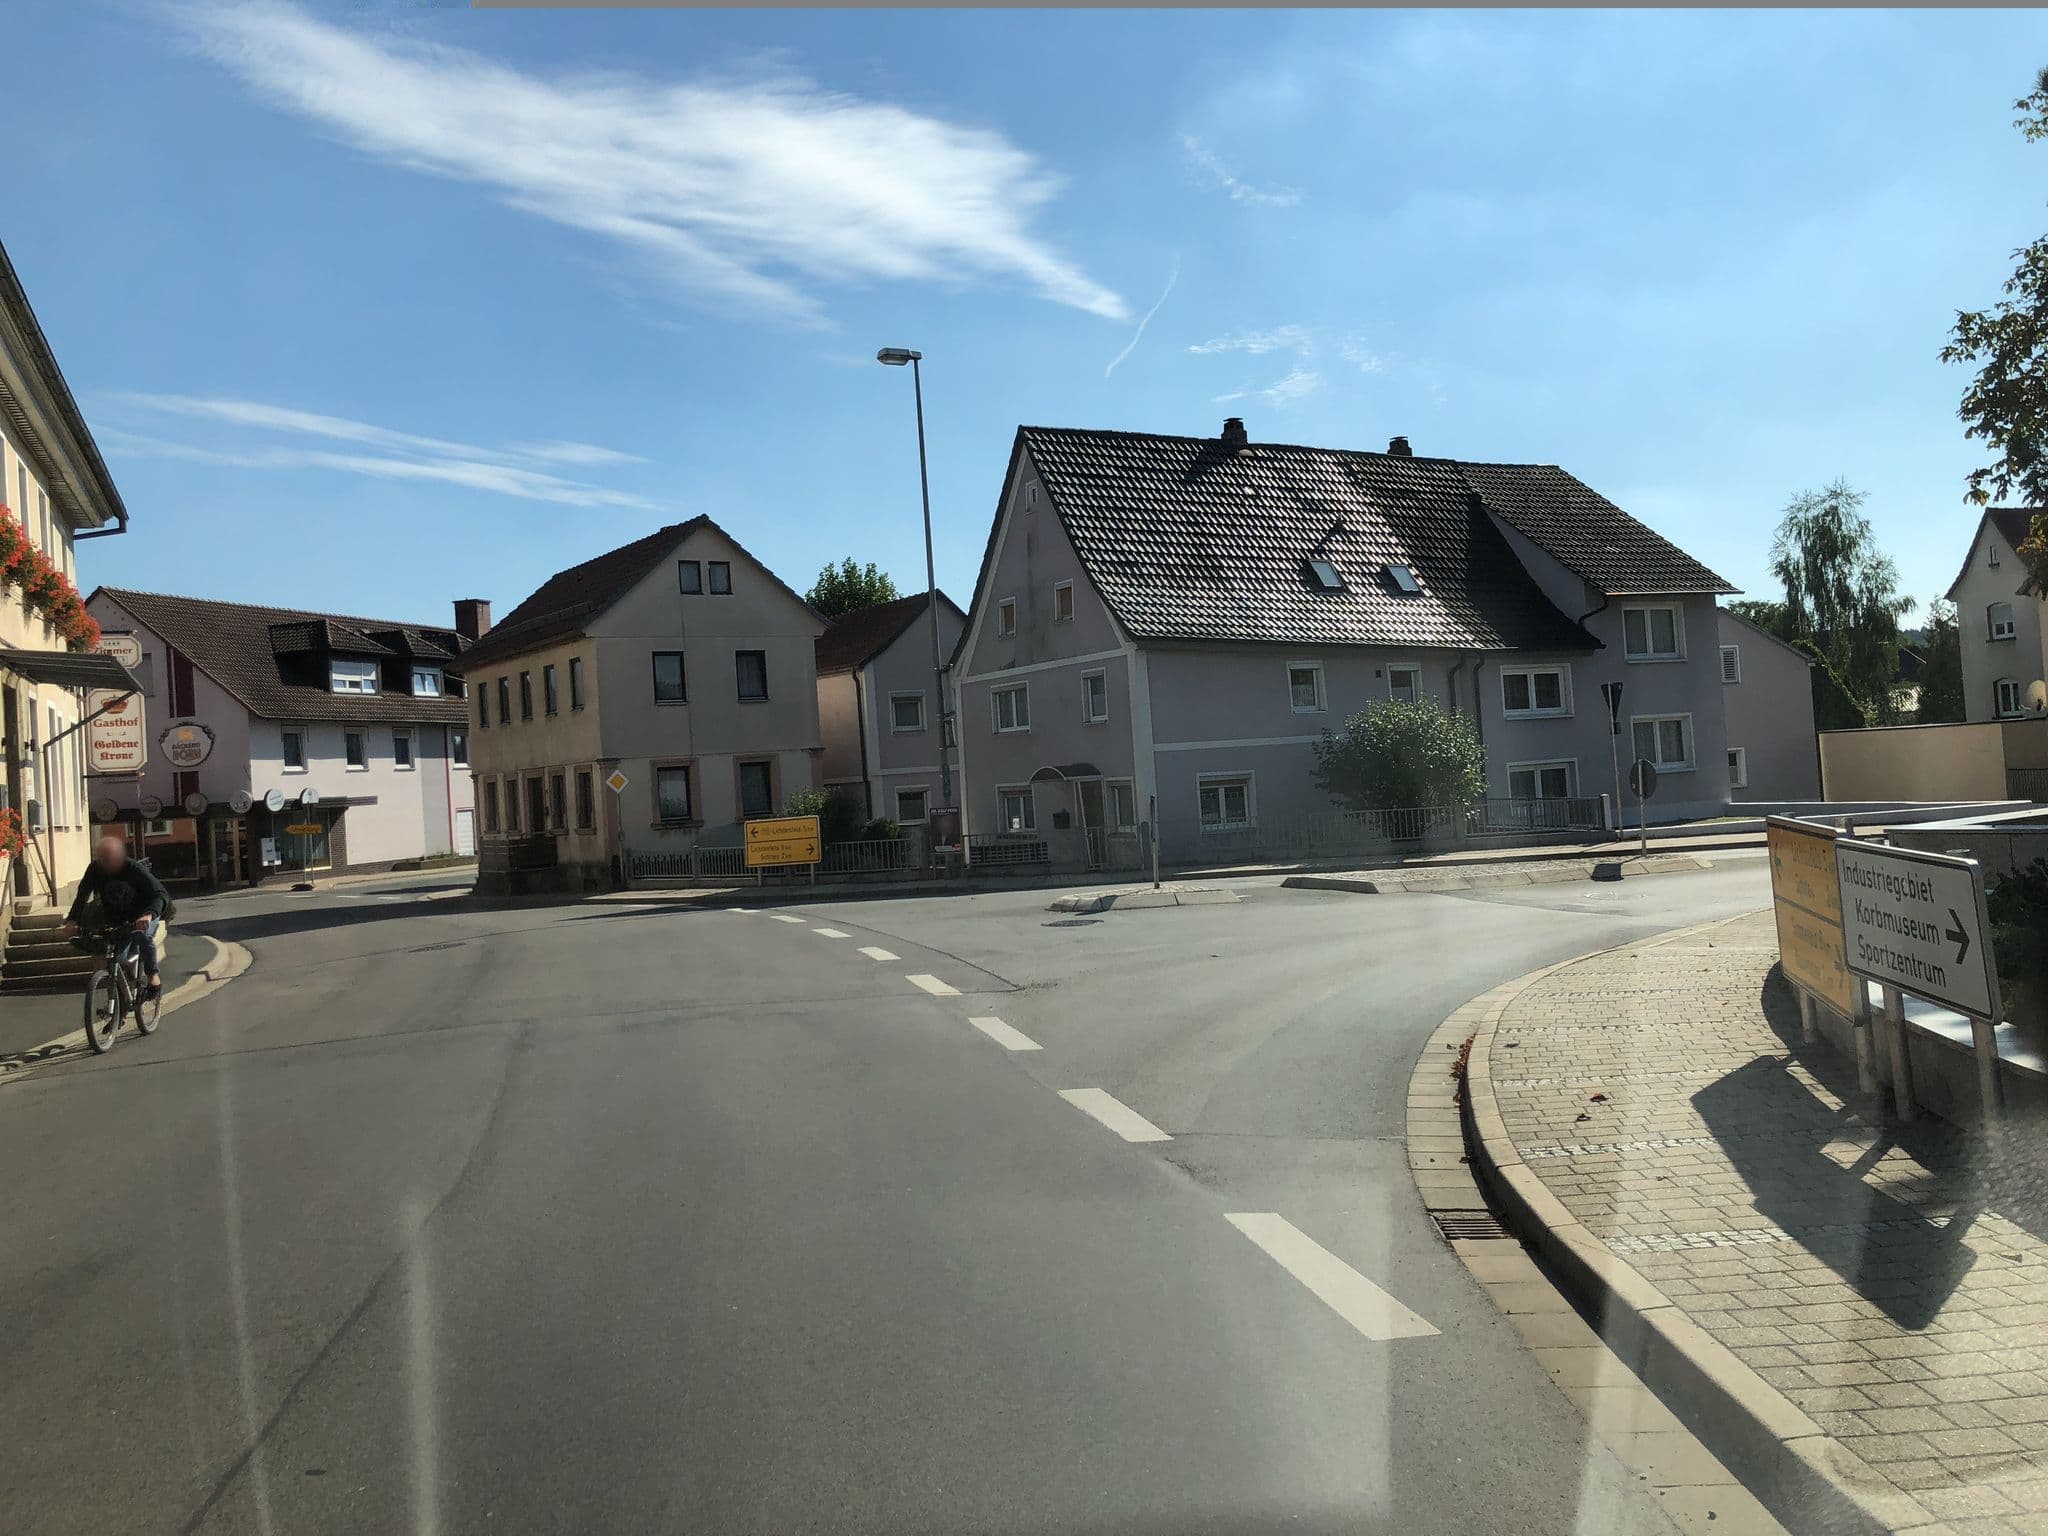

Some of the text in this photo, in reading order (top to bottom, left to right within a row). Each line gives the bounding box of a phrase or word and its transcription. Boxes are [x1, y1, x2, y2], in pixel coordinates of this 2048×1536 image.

[93, 717, 139, 727] Gasthof
[94, 740, 139, 749] Goldene
[100, 751, 134, 760] Krone
[1842, 858, 1935, 904] Industriegebiet
[1855, 897, 1941, 945] Korbmuseum
[1858, 934, 1947, 987] Sportzentrum
